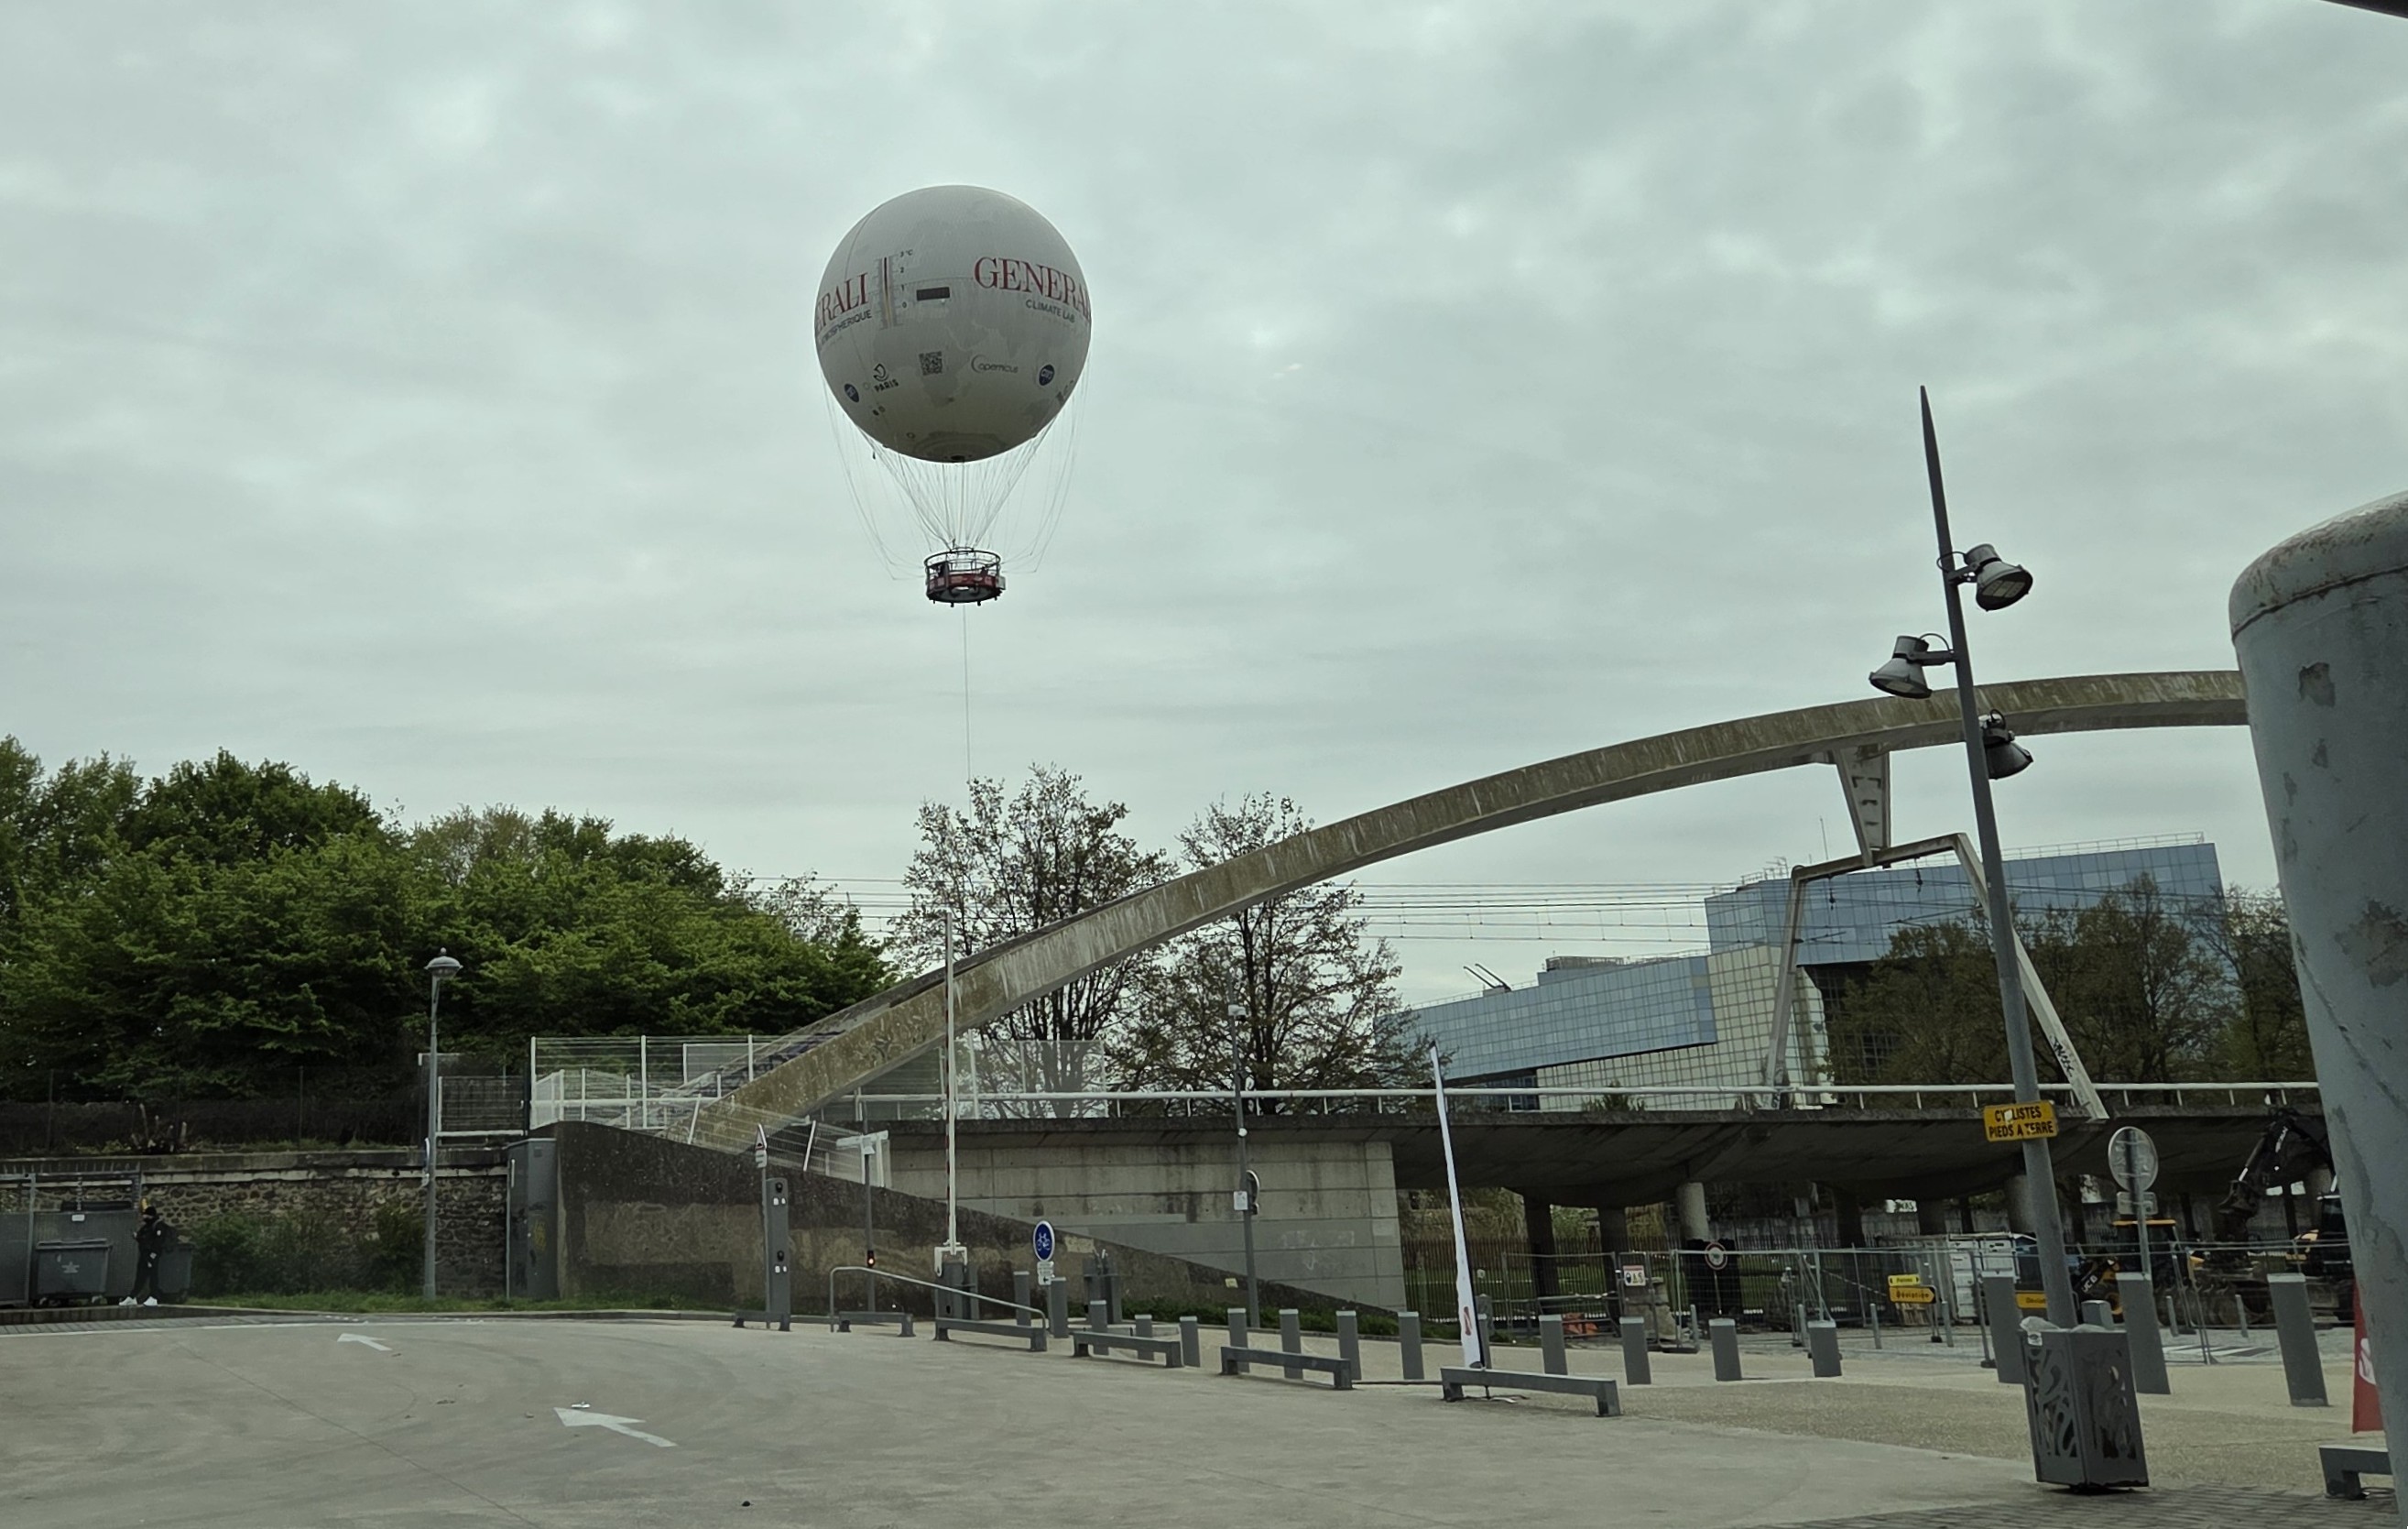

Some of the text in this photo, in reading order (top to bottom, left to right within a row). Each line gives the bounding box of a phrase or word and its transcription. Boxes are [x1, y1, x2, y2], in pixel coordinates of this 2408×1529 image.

[1025, 300, 1061, 317] CLIMATE
[874, 378, 899, 392] PARIS
[1994, 1106, 2042, 1123] CYLISTES
[1989, 1120, 2054, 1138] PIEDS A TERRE
[2081, 1274, 2098, 1293] JCB
